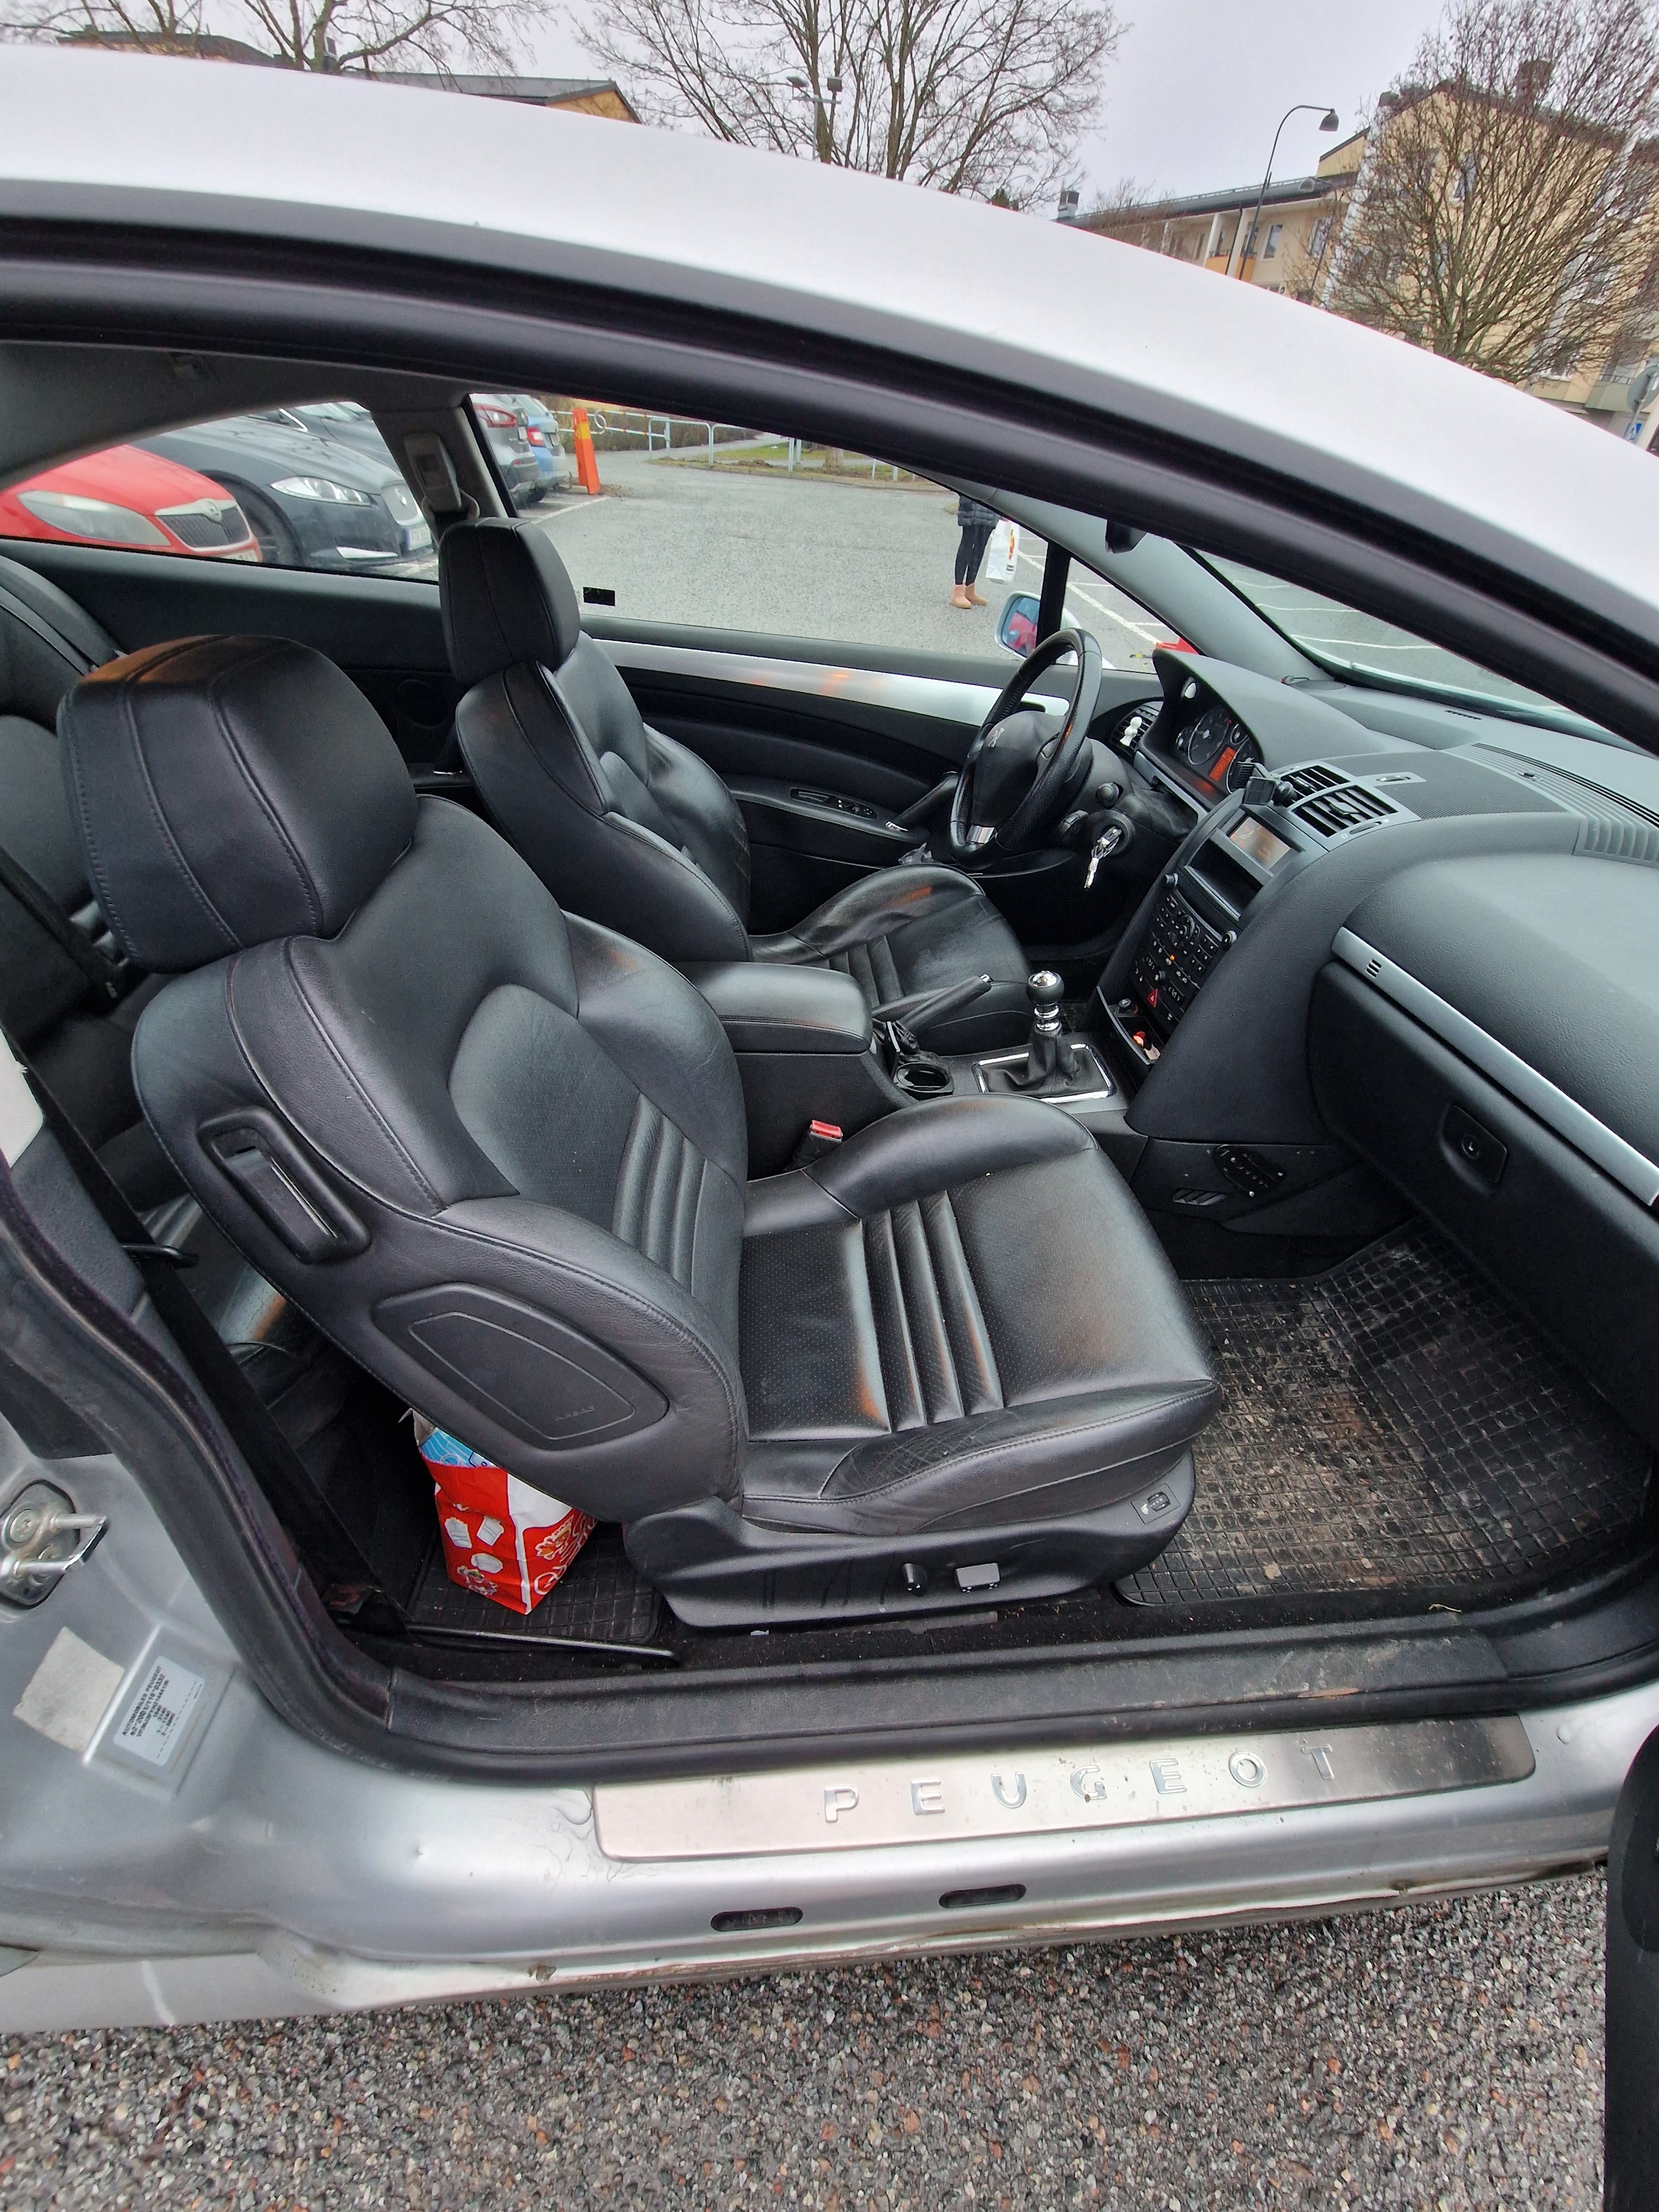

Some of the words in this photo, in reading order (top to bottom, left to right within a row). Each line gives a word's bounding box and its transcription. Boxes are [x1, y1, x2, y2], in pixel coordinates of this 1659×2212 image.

[122, 1693, 147, 1735] AUTOMOBILES
[145, 1666, 161, 1691] PEUGEOT
[823, 1744, 1334, 1823] PEUGEOT
